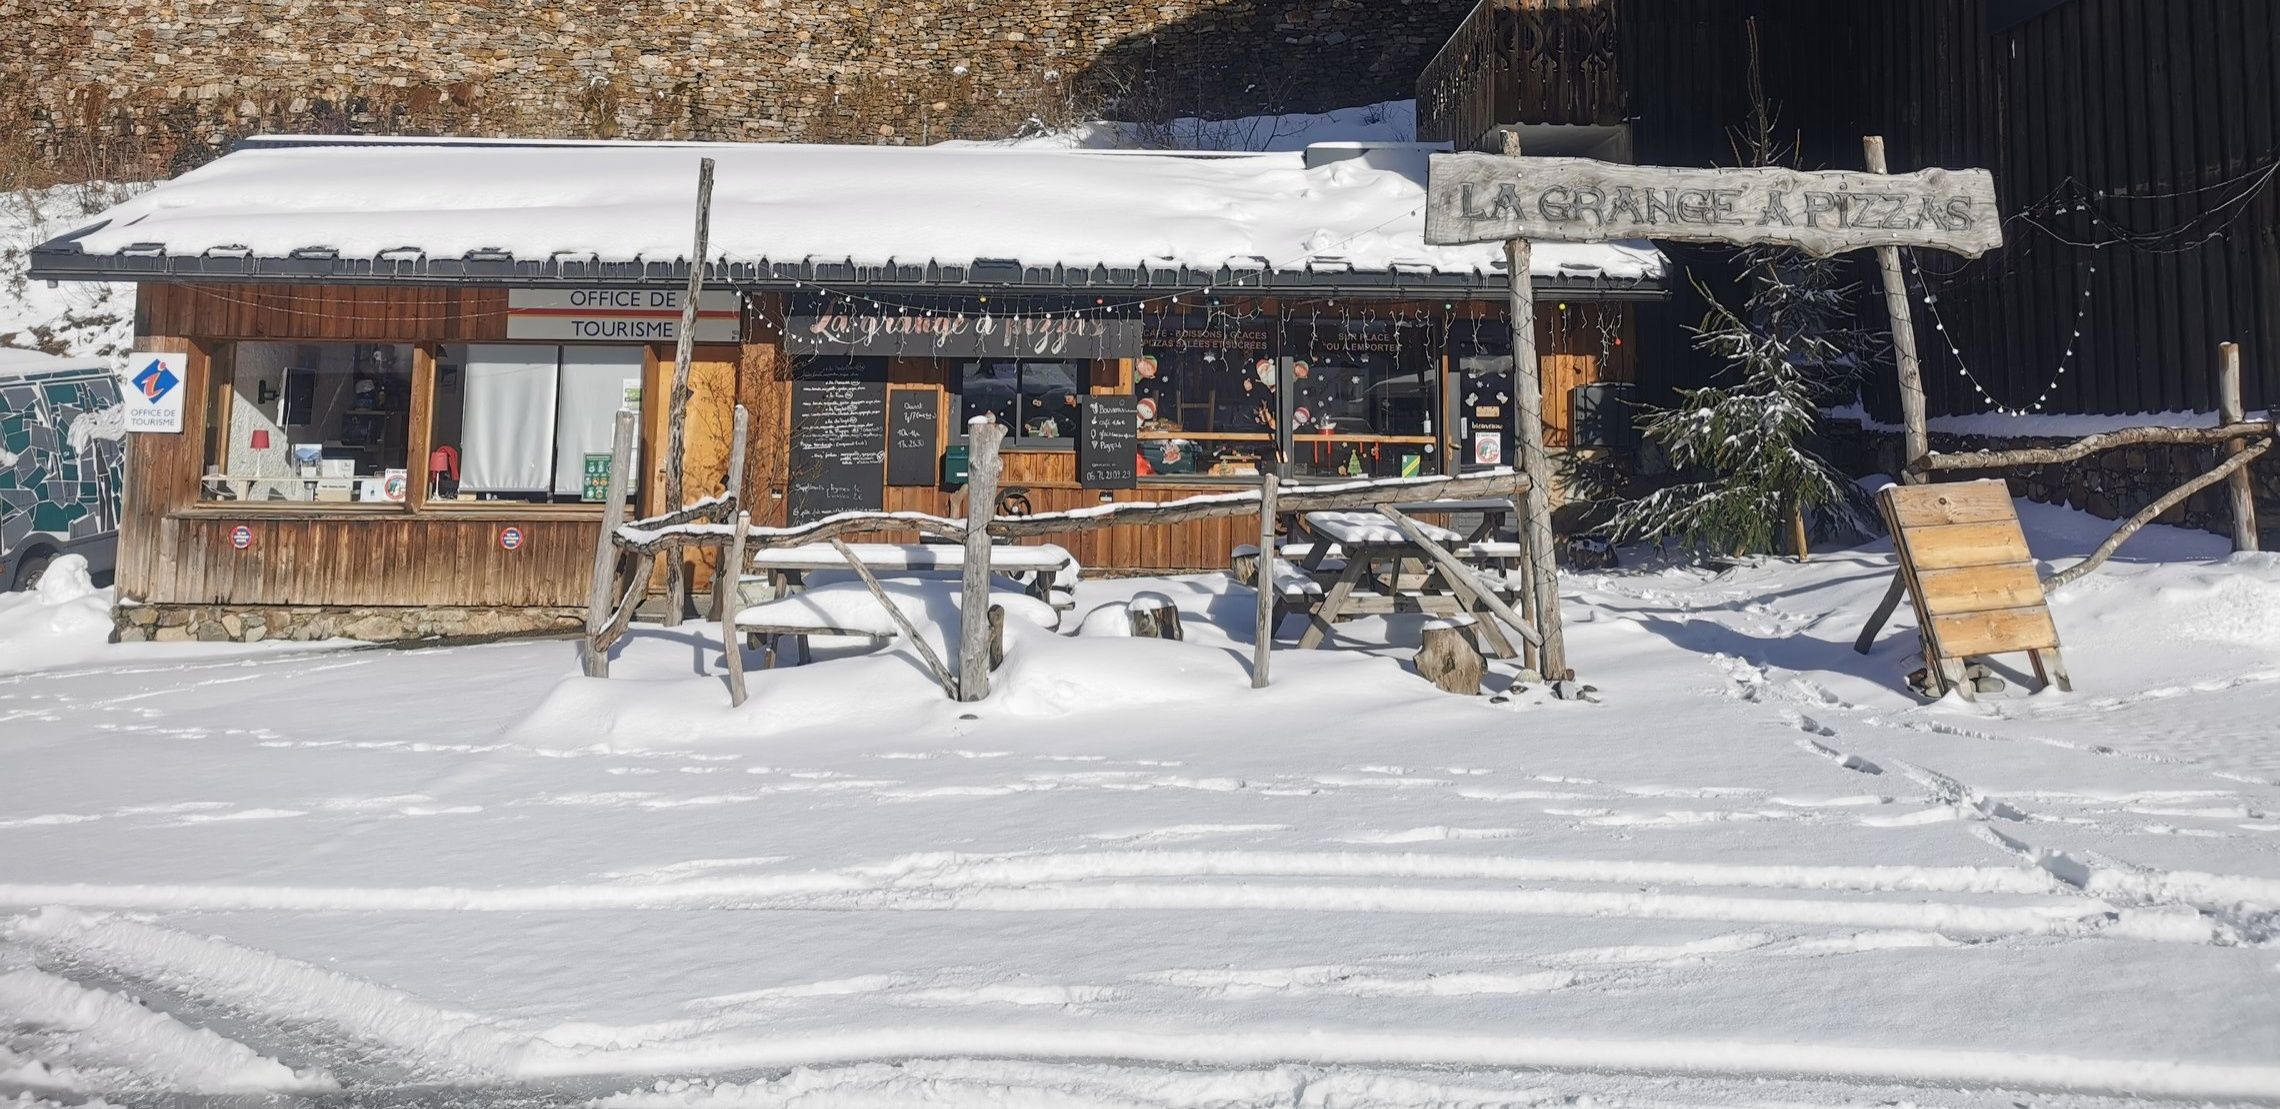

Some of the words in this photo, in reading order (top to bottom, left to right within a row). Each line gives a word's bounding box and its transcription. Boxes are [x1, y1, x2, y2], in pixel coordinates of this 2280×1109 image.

[1459, 182, 1528, 221] LA
[1537, 184, 1745, 226] GRANGE
[570, 290, 641, 307] OFFICE
[644, 291, 677, 307] DE
[571, 320, 674, 337] TOURISME
[860, 313, 969, 347] grange
[1003, 315, 1106, 355] pizzas
[1338, 333, 1357, 341] SUR
[1359, 333, 1391, 342] PLACE
[1326, 342, 1340, 351] OU
[130, 408, 161, 417] OFFICE
[163, 409, 176, 417] DE
[131, 418, 175, 426] TOURISME
